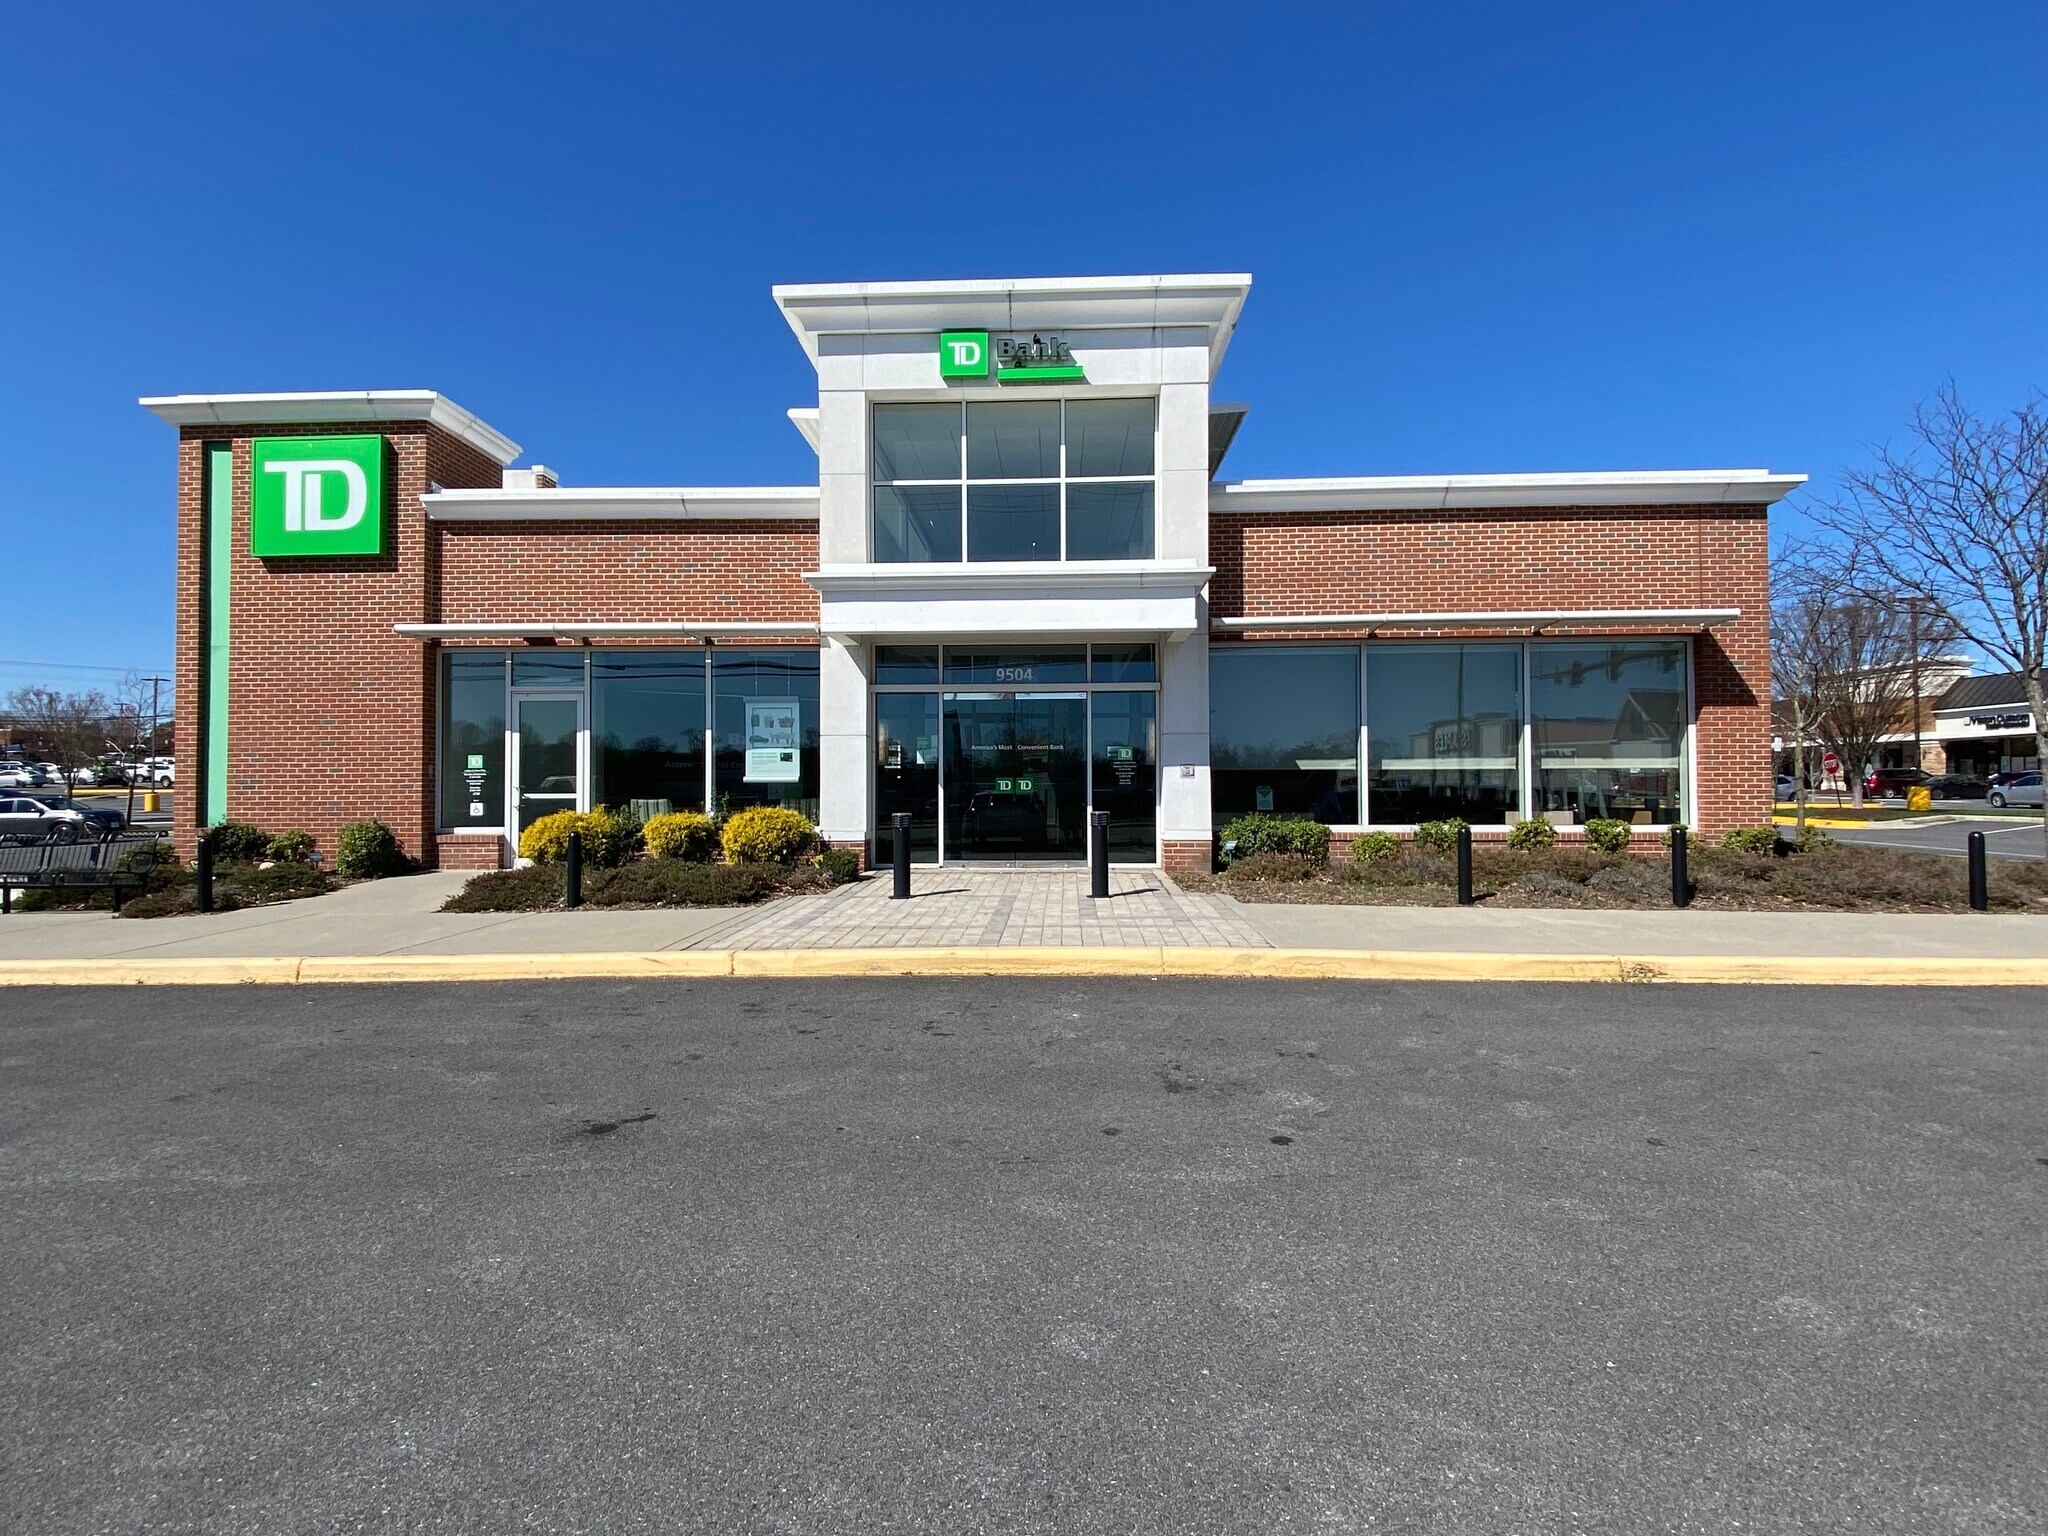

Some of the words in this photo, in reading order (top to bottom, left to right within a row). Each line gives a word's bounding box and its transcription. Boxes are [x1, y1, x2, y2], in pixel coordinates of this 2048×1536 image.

[948, 342, 981, 366] TD
[997, 337, 1069, 360] Bank
[264, 459, 368, 532] TD
[996, 668, 1032, 682] 9504
[1824, 759, 1838, 769] STOP
[997, 780, 1012, 791] TD
[1017, 780, 1032, 791] TD
